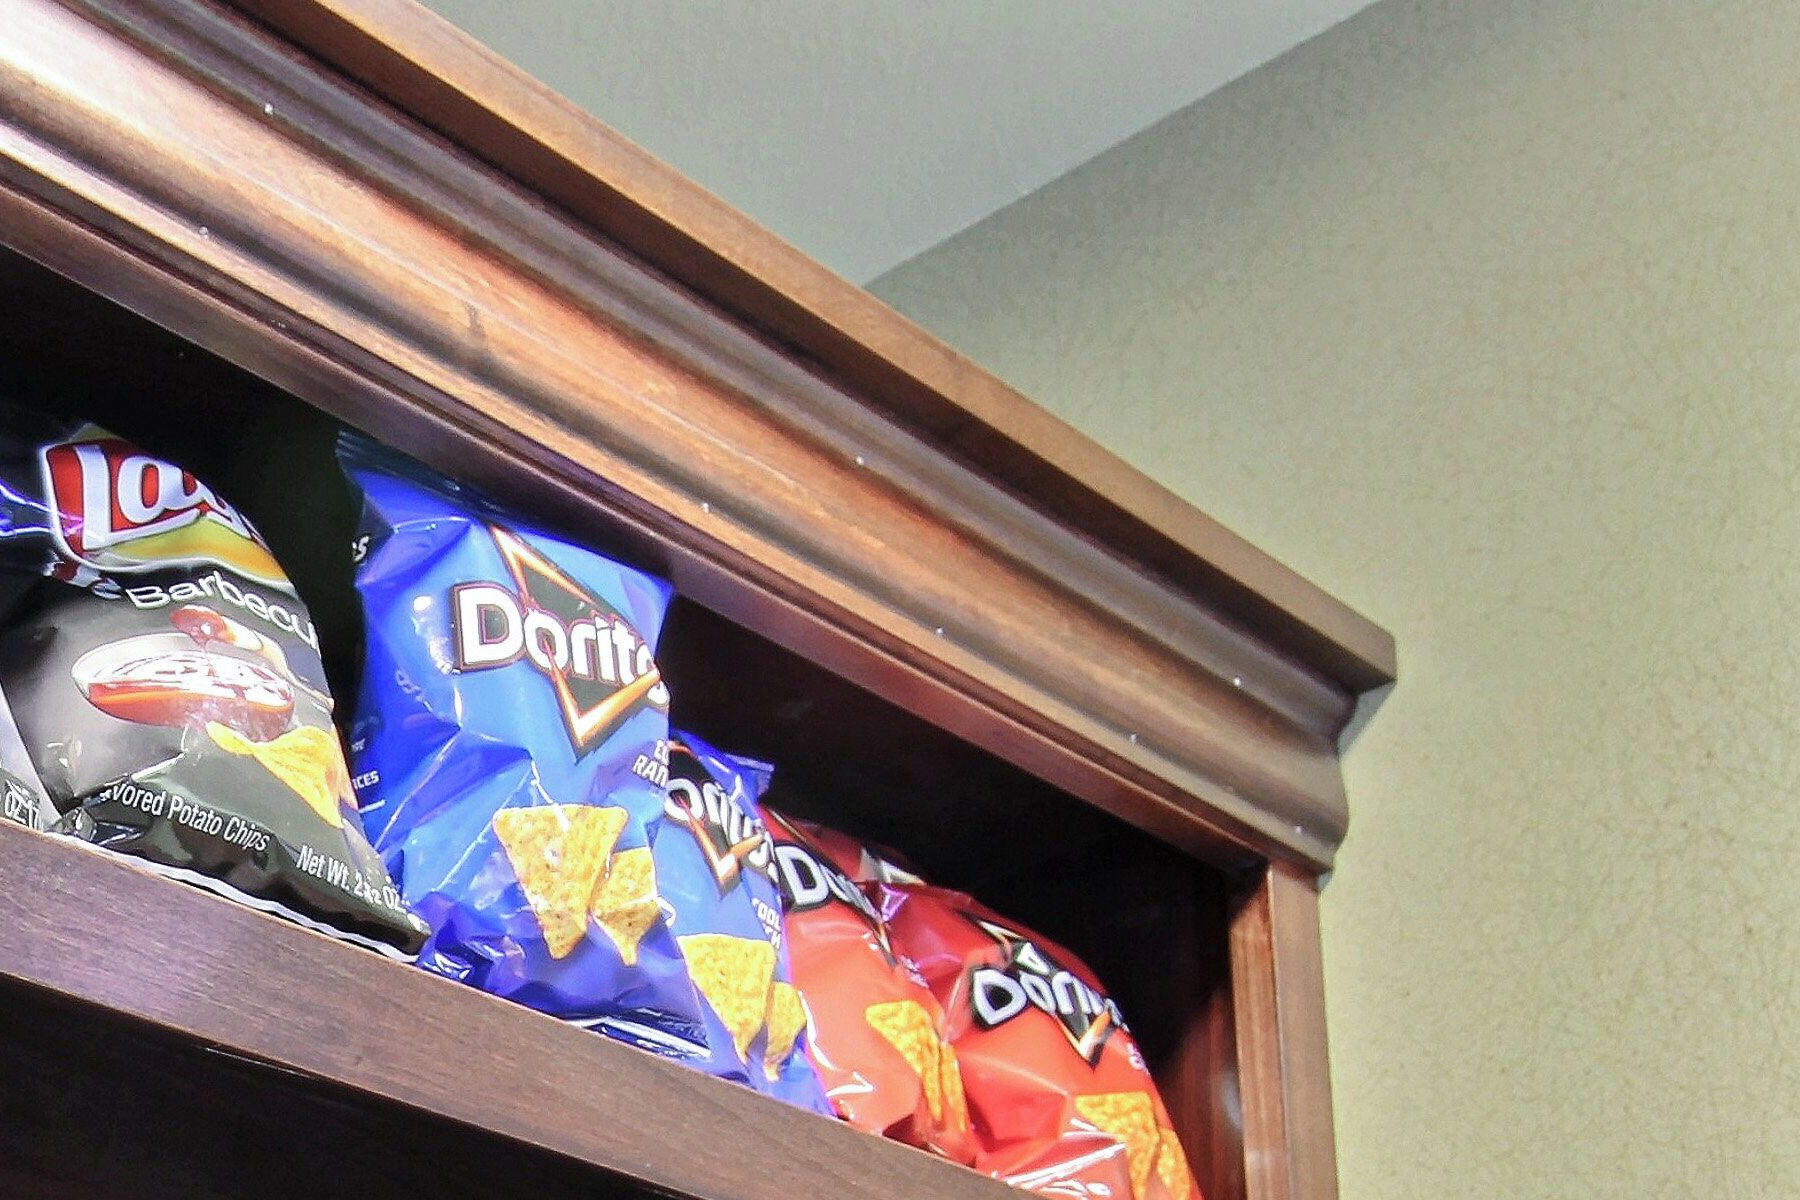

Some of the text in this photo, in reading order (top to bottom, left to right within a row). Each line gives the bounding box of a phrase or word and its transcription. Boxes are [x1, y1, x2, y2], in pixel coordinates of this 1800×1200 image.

[127, 570, 320, 650] Barbecu
[632, 754, 669, 788] RAN
[99, 783, 271, 852] vored Potato Chips
[296, 845, 326, 879] Net
[327, 857, 350, 891] Wt.
